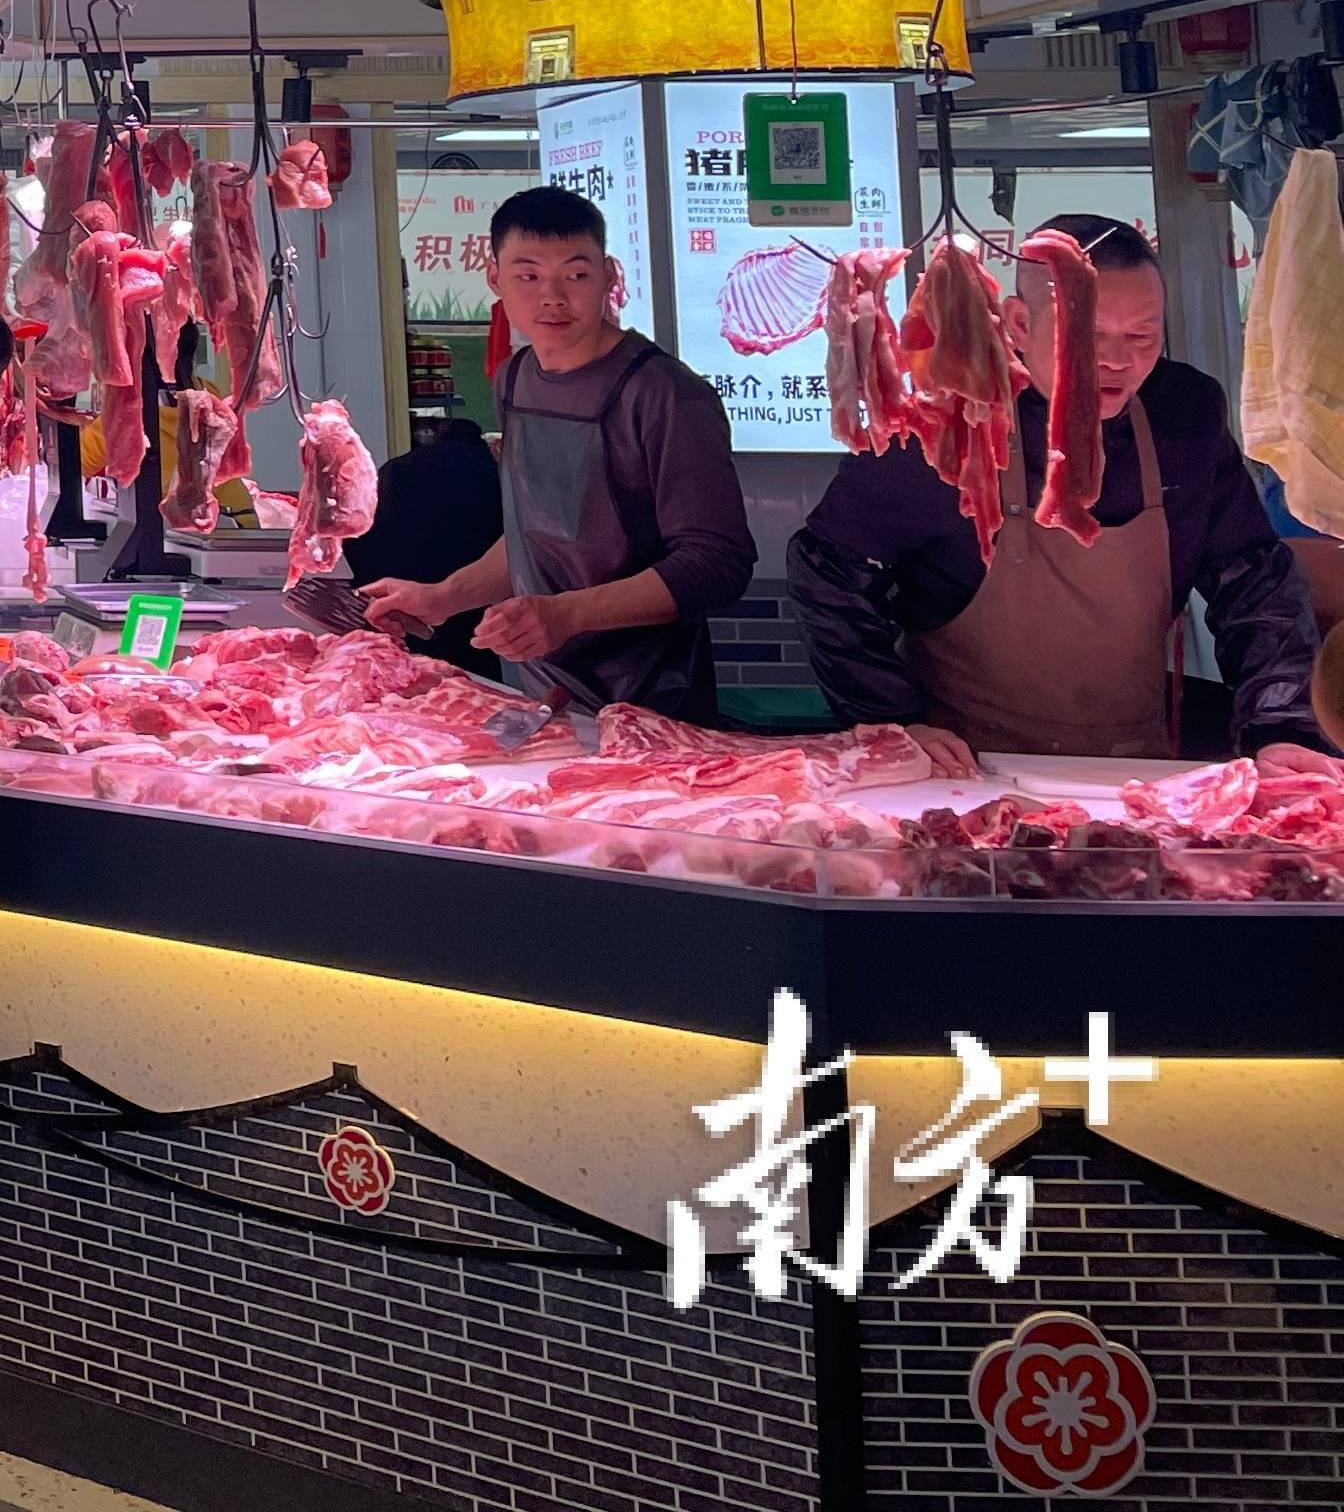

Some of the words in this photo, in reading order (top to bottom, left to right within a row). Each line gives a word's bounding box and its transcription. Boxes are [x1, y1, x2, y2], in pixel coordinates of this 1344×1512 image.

[696, 131, 745, 144] POR
[684, 148, 746, 177] 猪
[413, 233, 493, 273] 积极
[705, 374, 827, 400] 脉介，就系
[785, 407, 823, 424] JUST
